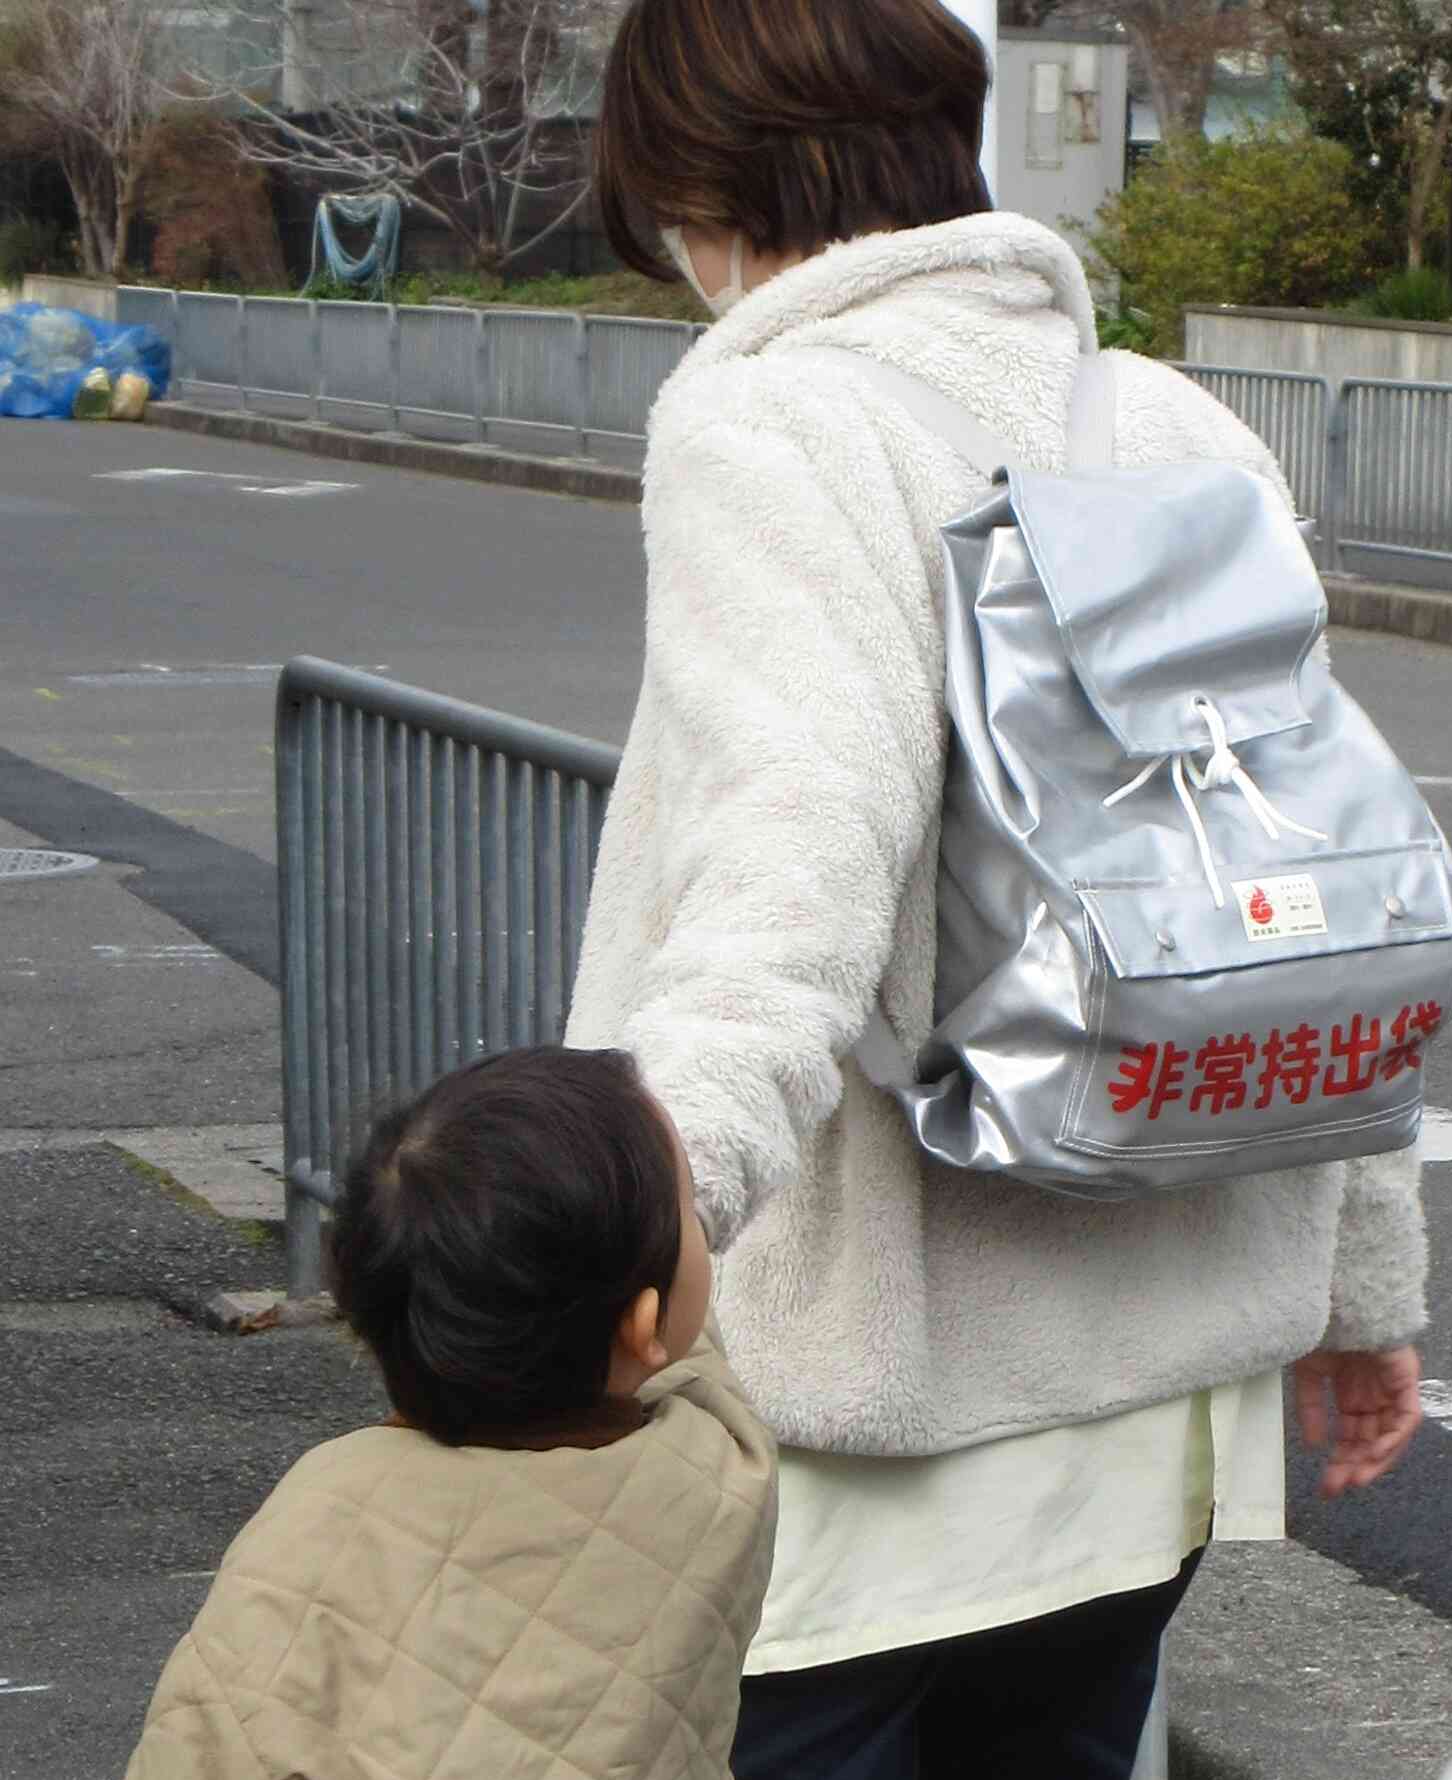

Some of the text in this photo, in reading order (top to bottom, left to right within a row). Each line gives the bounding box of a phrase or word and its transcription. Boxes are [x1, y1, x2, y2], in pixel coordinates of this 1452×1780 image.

[1107, 1000, 1441, 1120] 非常持出袋
